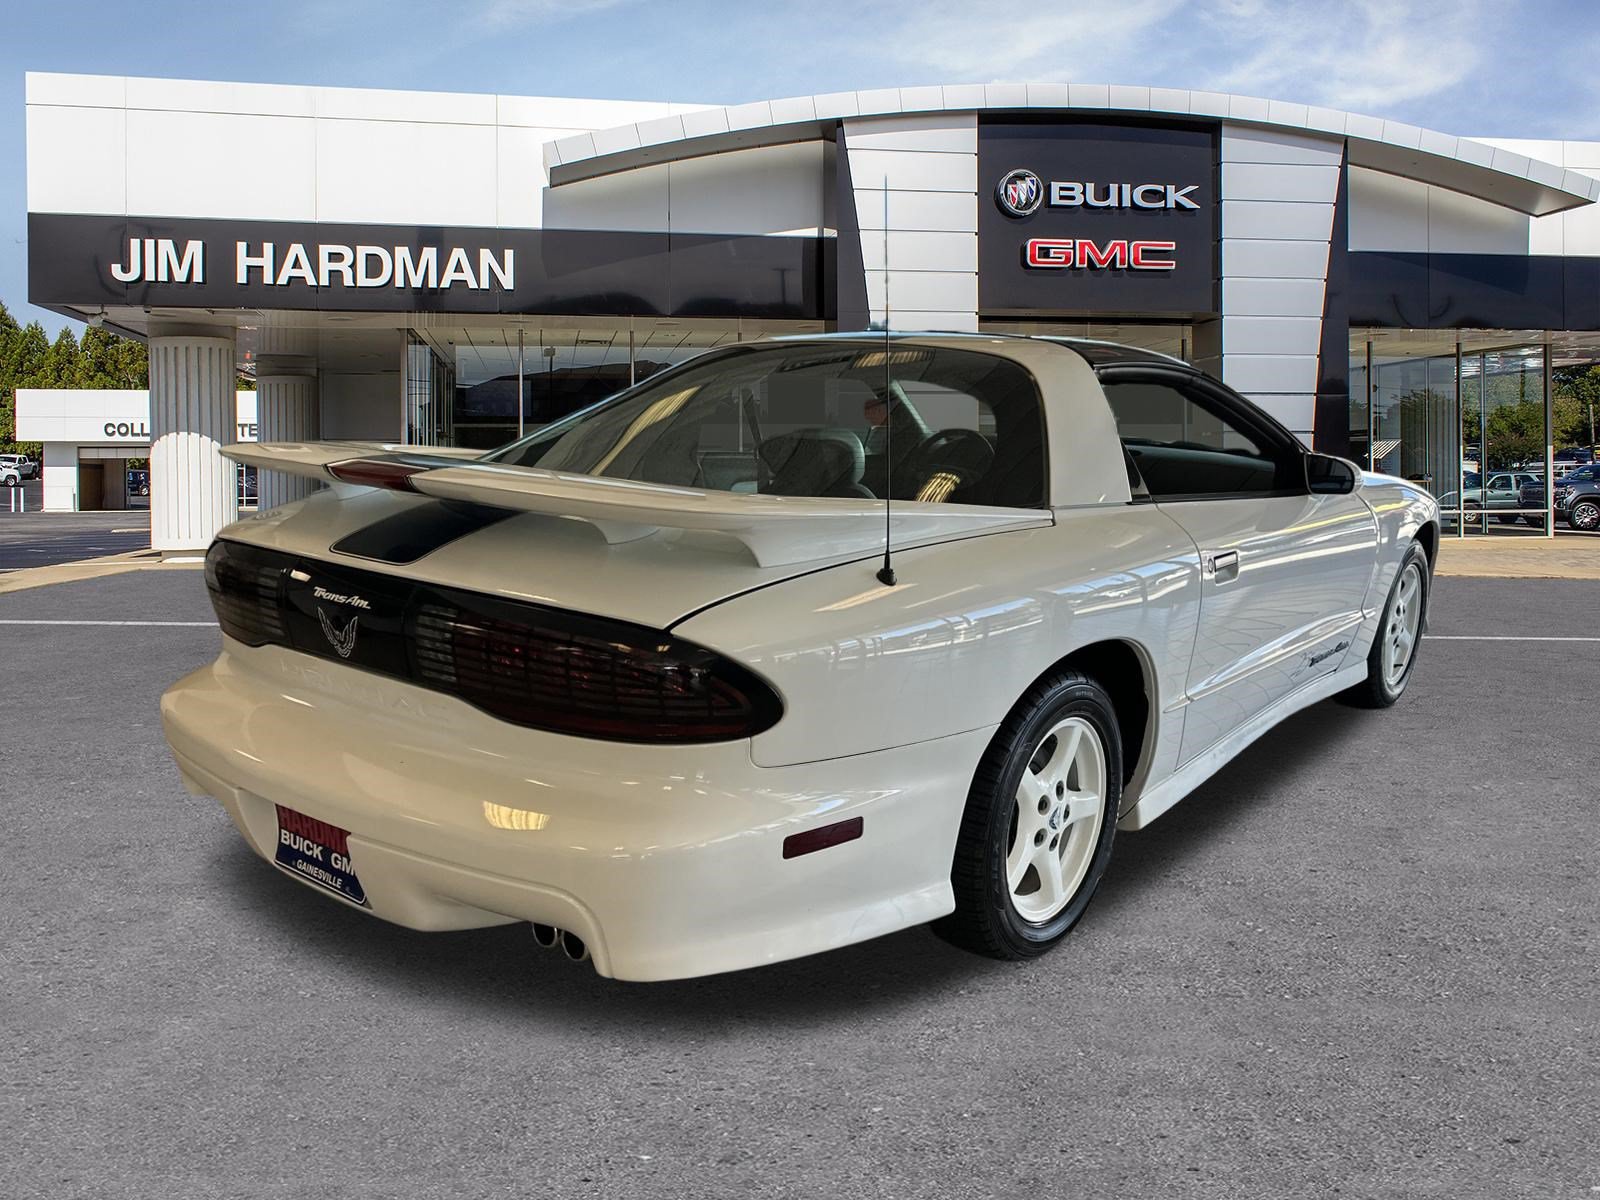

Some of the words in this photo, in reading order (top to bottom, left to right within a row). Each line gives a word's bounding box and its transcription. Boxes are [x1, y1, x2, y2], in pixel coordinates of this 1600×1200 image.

[1050, 181, 1200, 209] BUICK
[111, 238, 205, 284] JIM
[236, 241, 515, 291] HARDMAN
[1026, 238, 1176, 269] GMC
[313, 586, 347, 603] Trans
[345, 595, 371, 609] Am
[280, 829, 323, 861] BUICK
[296, 859, 343, 889] GAINESVILLE
